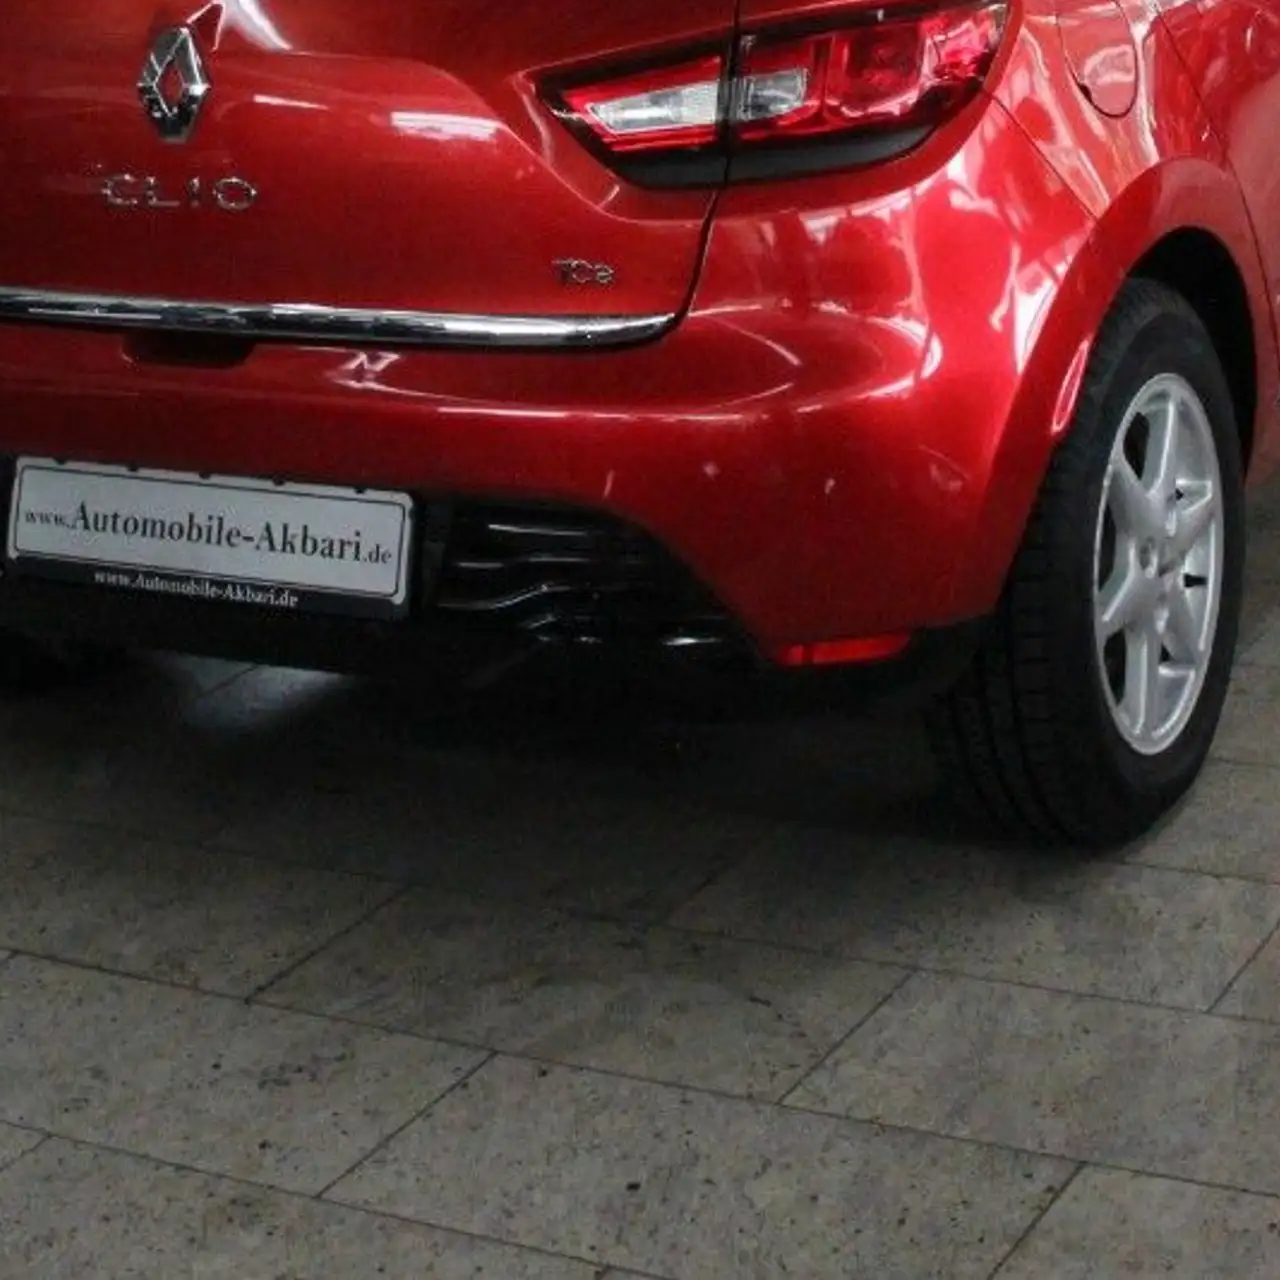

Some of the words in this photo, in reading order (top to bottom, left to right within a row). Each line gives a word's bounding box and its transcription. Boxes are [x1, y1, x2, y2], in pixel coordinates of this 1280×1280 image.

[101, 173, 258, 211] CLIO
[25, 500, 393, 565] www.Automobile-Akbari.de
[94, 571, 298, 607] www.Automobile-Akbari.de
